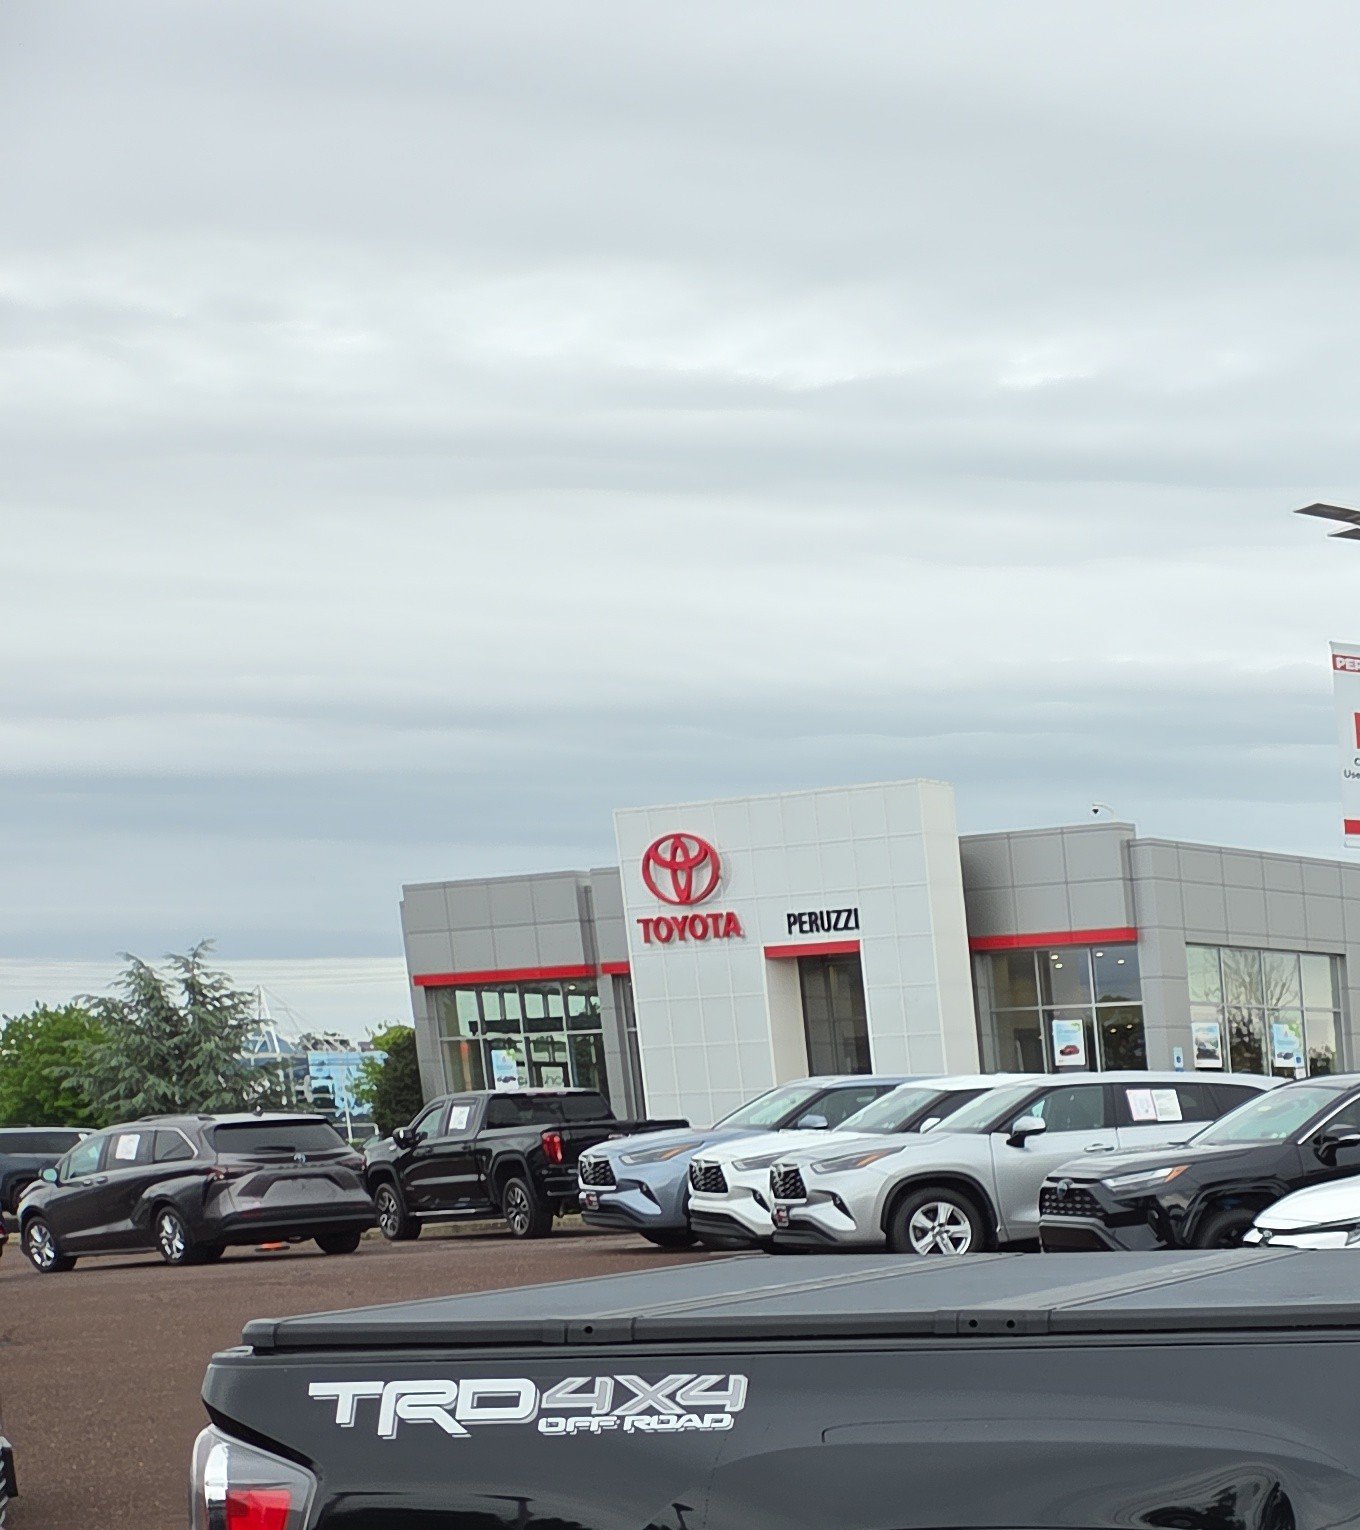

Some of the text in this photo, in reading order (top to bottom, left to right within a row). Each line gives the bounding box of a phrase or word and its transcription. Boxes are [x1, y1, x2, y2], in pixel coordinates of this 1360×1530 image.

[637, 912, 743, 943] TOYOTA
[786, 908, 860, 935] PERUZZI
[308, 1373, 749, 1440] TRD 4X4
[537, 1412, 736, 1436] OFF ROAD
